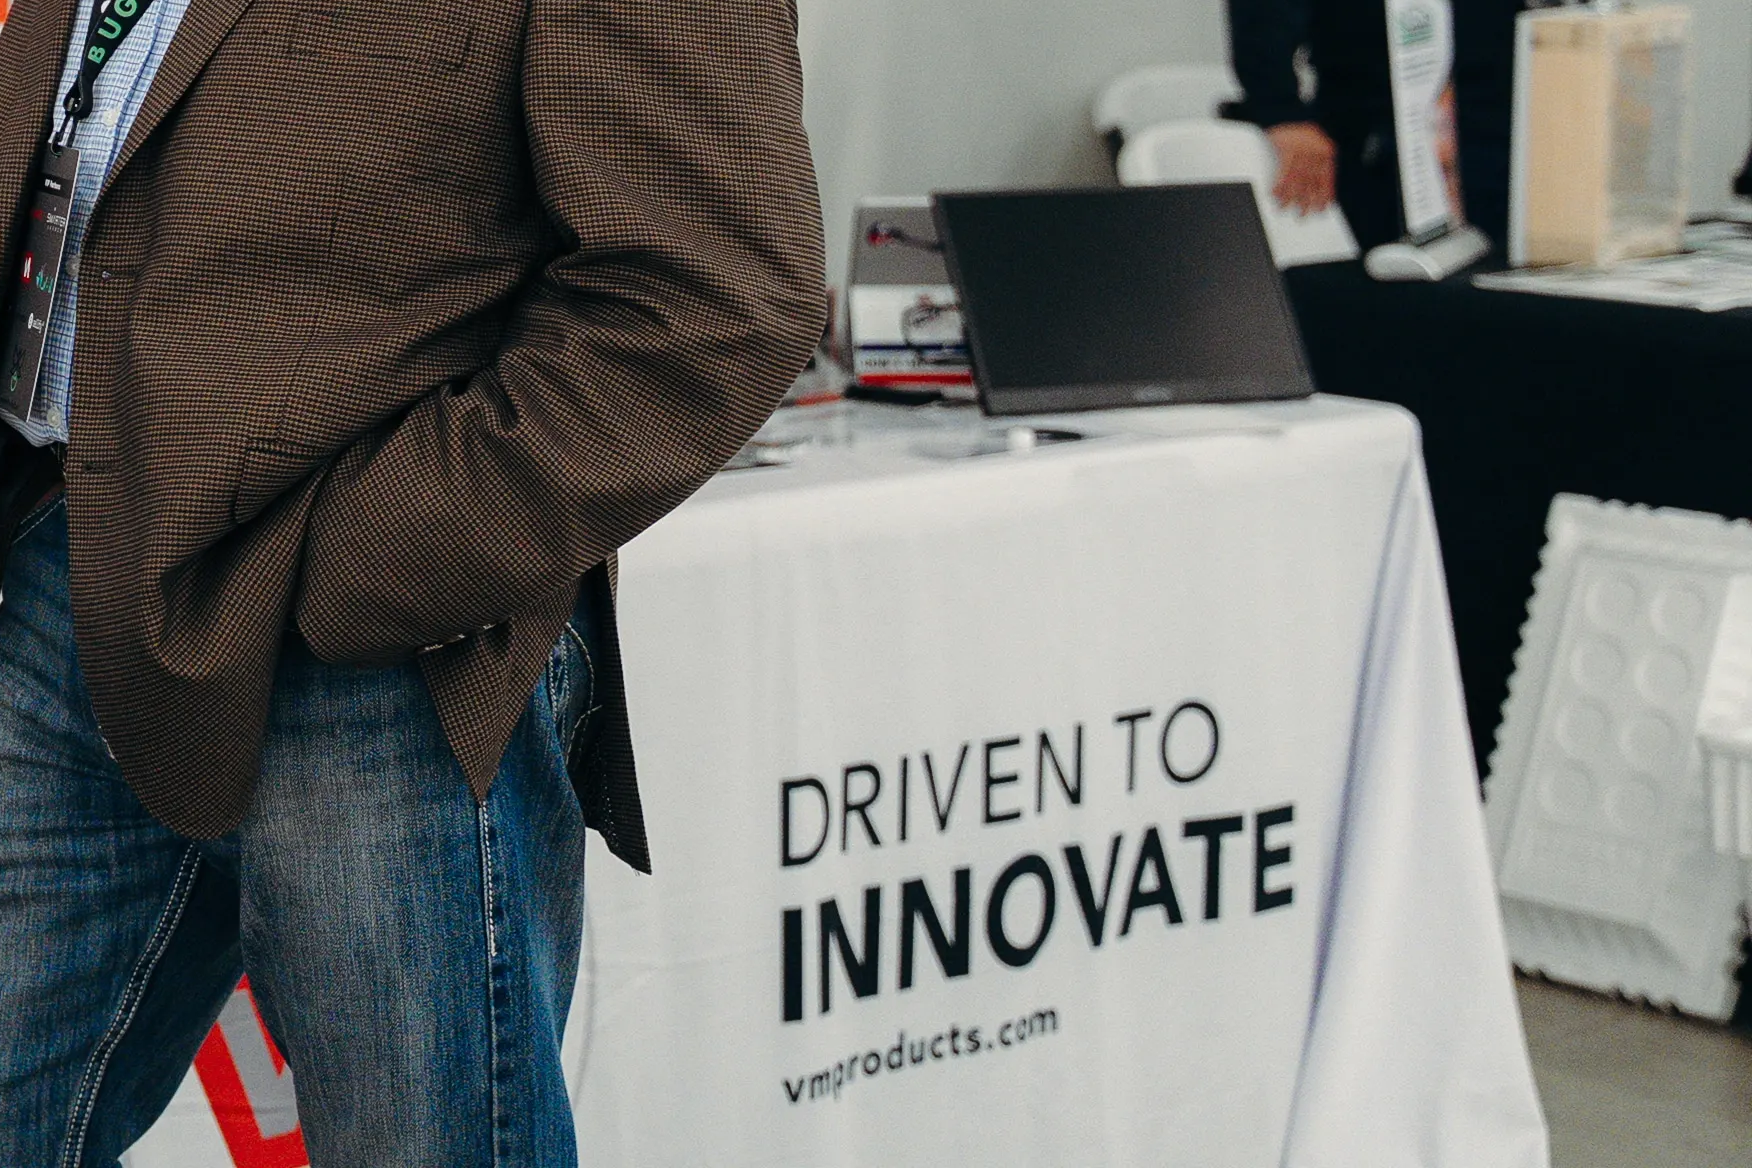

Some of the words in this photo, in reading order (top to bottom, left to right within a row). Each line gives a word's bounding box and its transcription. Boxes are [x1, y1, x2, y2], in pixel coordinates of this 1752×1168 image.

[779, 722, 1085, 868] DRIVEN
[1113, 699, 1220, 794] TO
[781, 804, 1295, 1024] INNOVATE
[782, 1007, 1060, 1105] vmproducts.com
